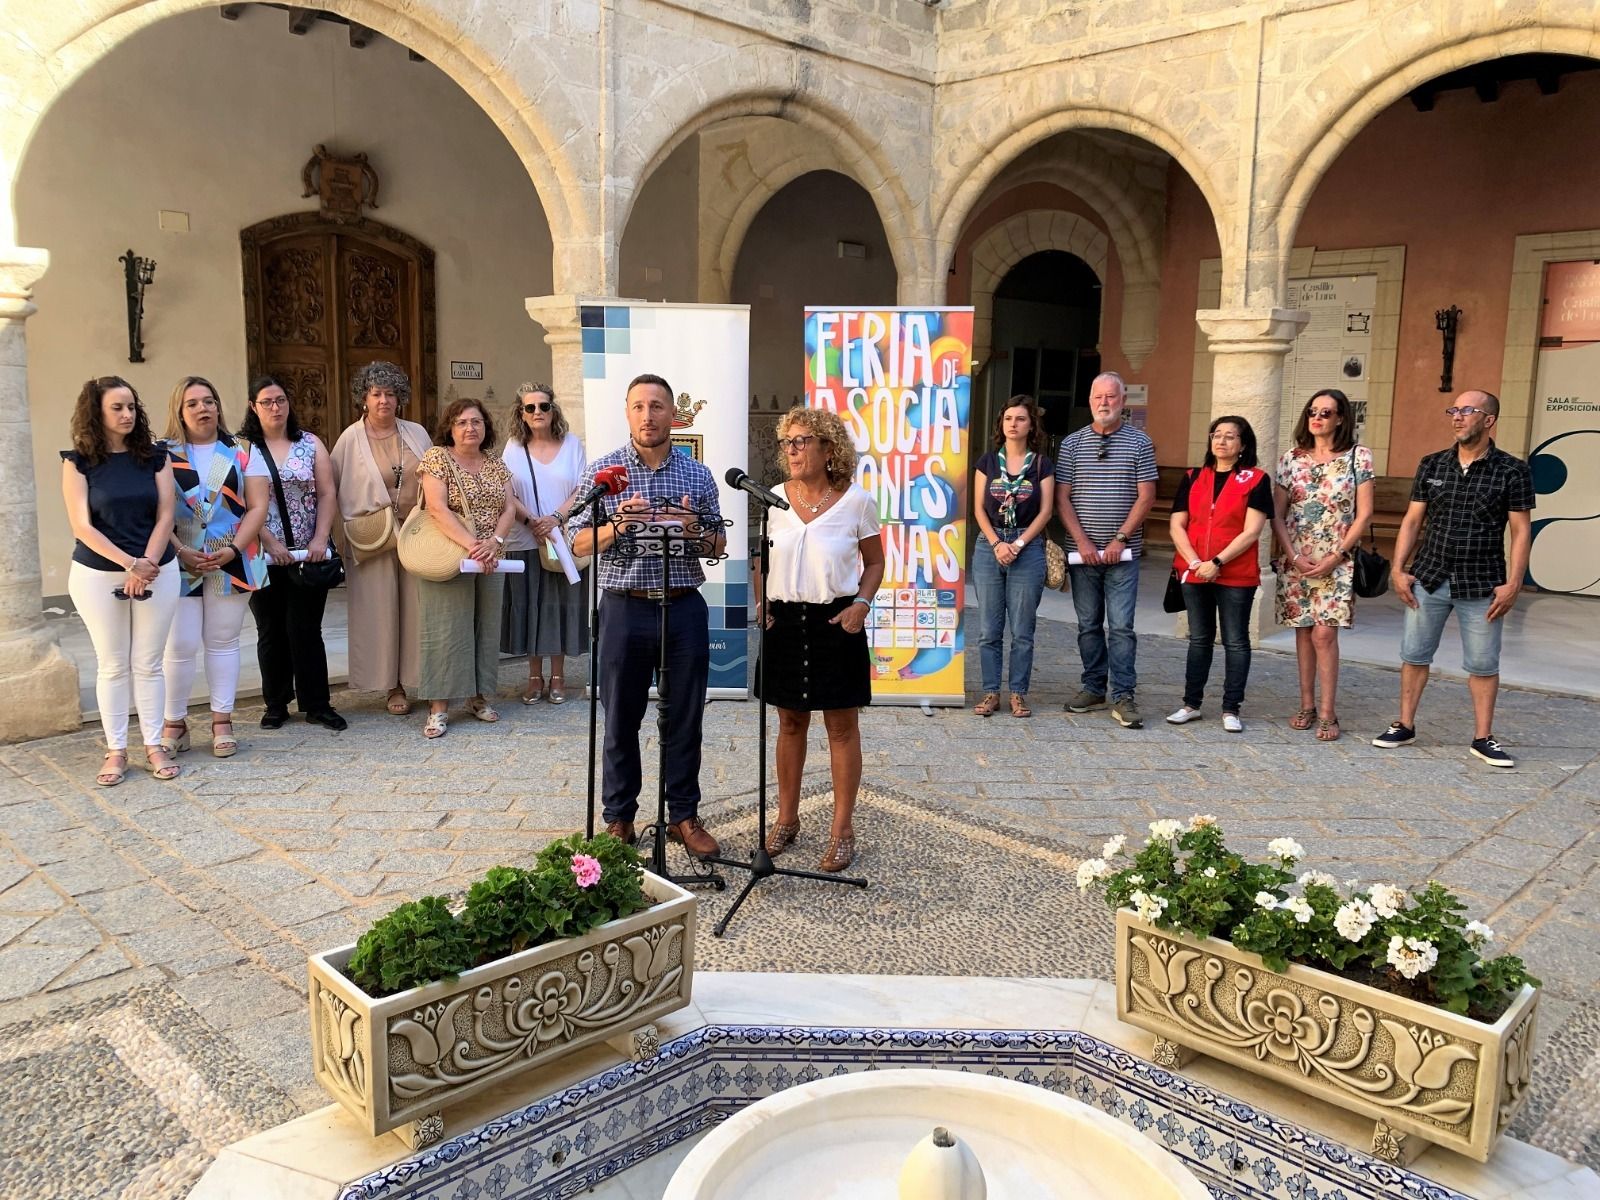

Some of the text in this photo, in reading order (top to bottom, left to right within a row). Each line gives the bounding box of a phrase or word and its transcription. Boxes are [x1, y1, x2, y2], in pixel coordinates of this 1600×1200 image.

[815, 312, 960, 389] FERIA DE
[856, 454, 948, 520] ONES
